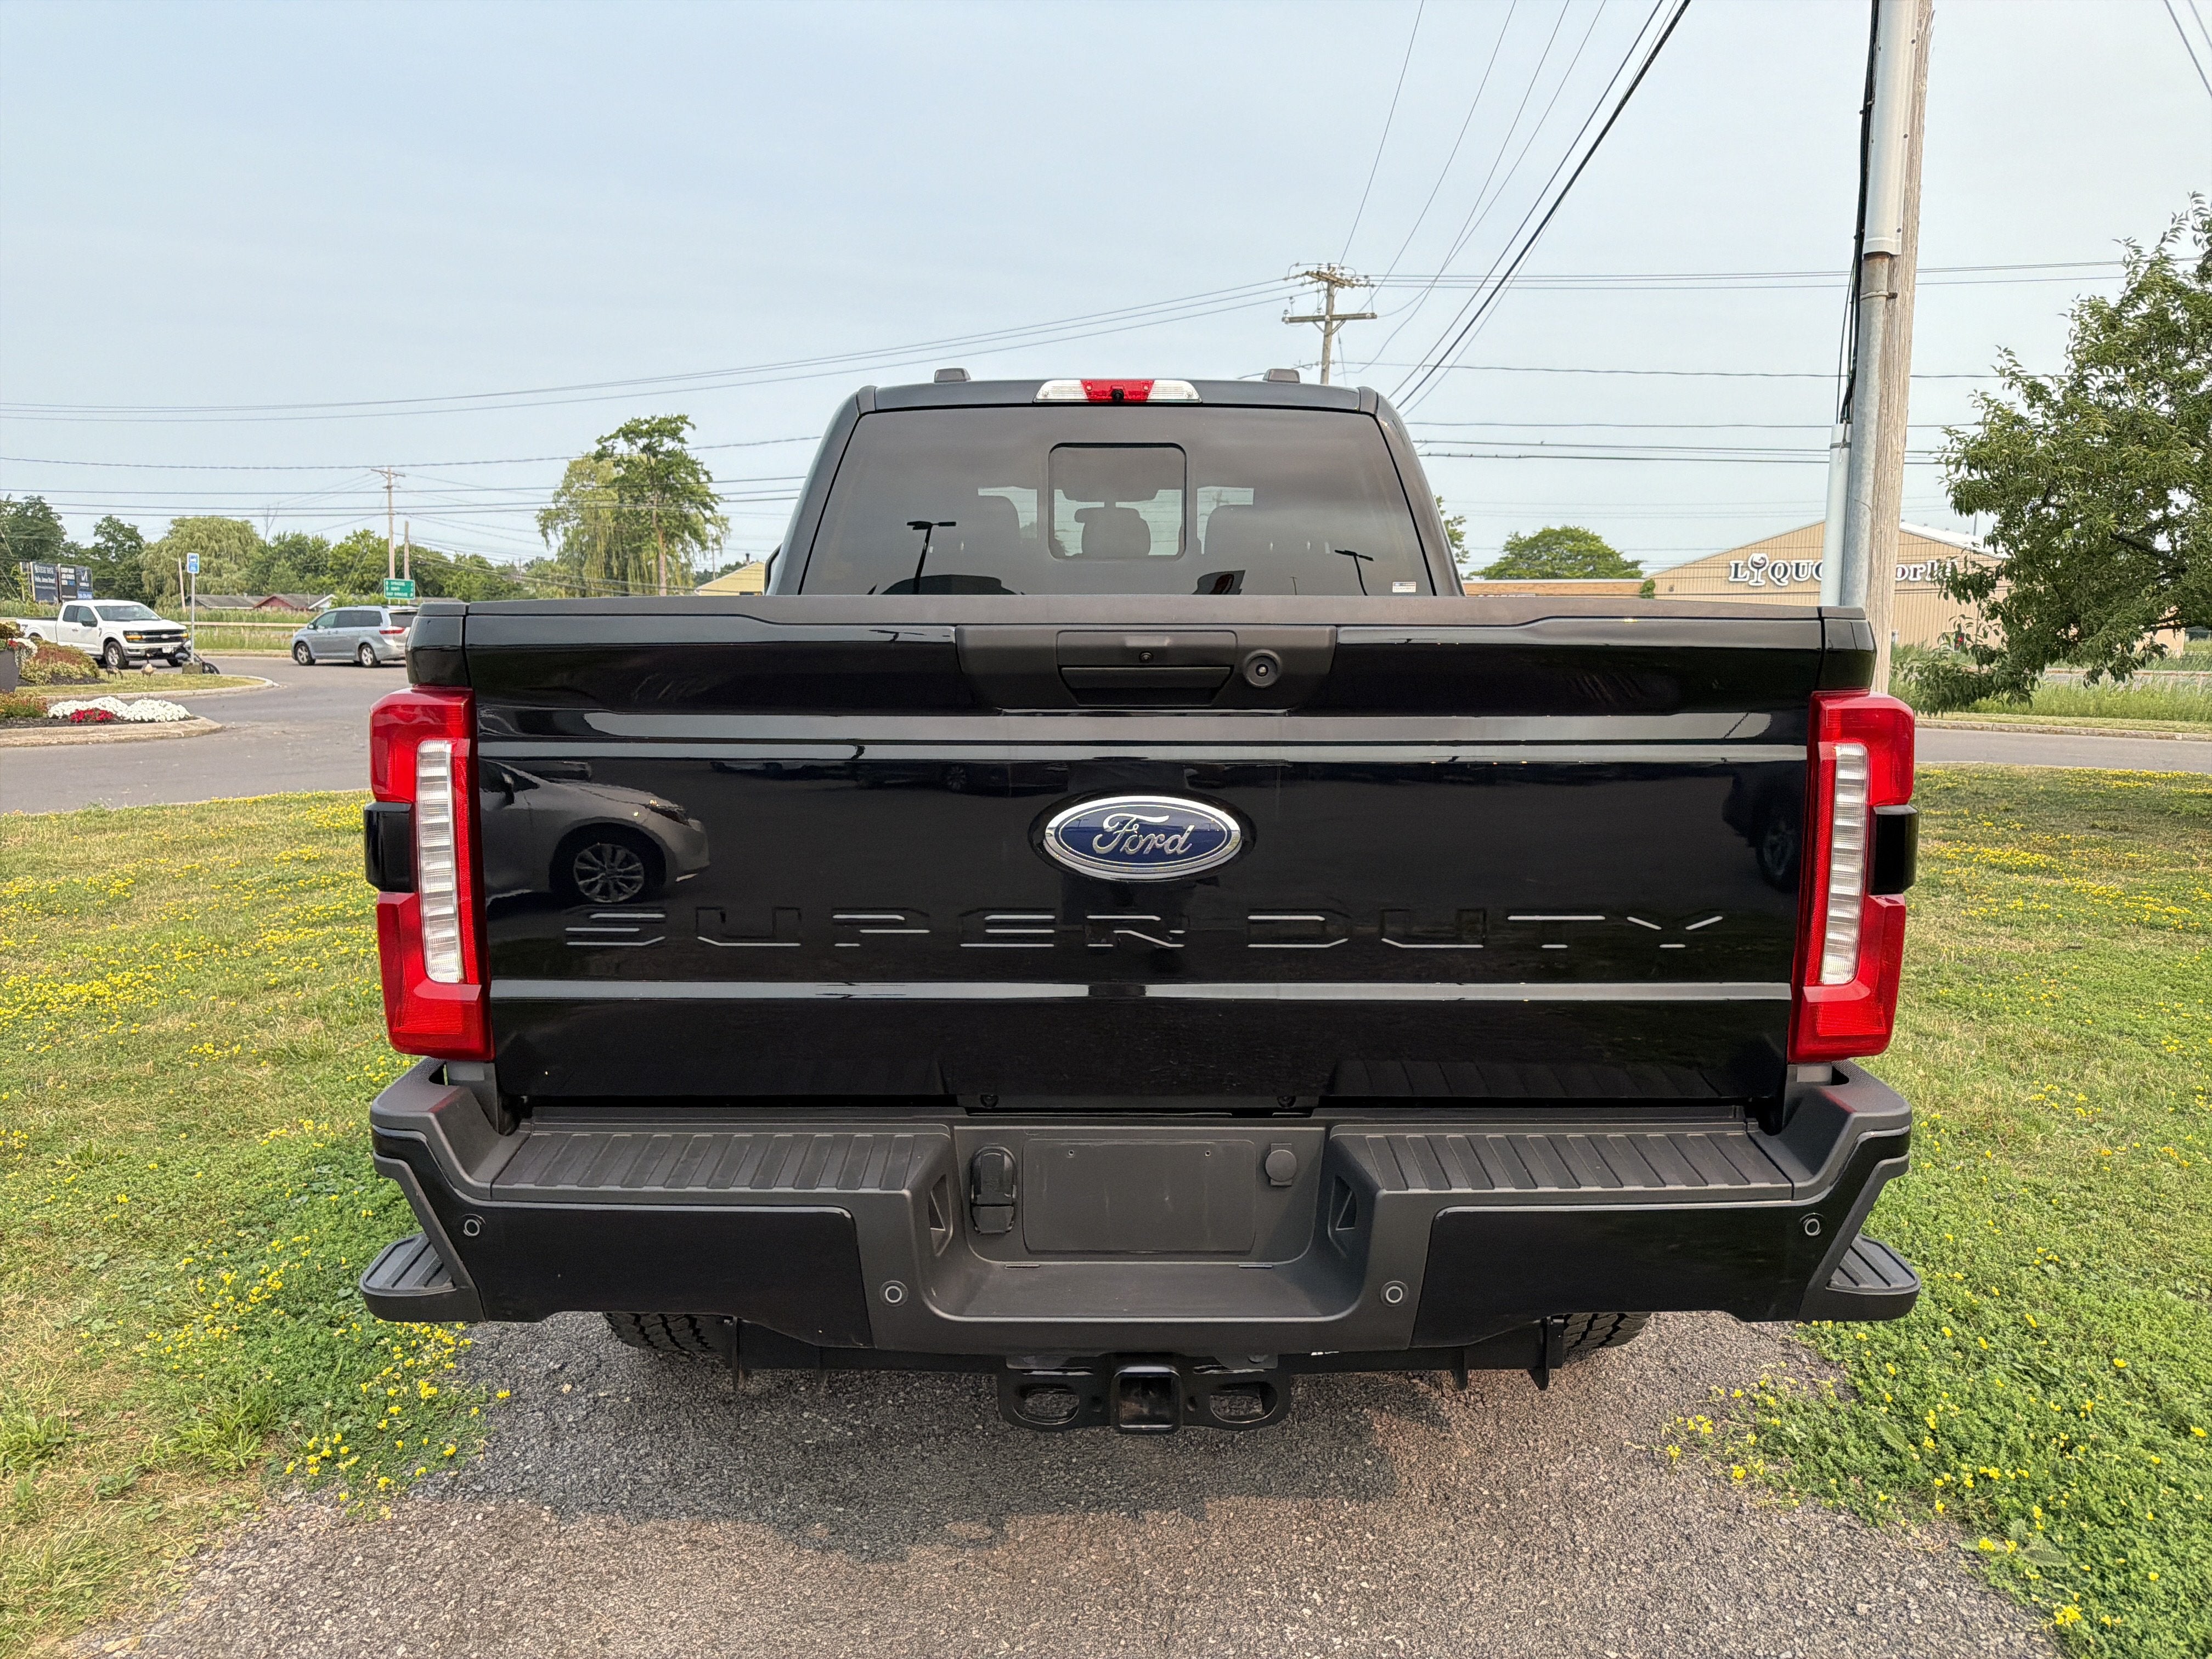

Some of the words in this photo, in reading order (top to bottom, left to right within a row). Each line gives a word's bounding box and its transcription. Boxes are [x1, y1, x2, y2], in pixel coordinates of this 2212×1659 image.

[1729, 553, 1822, 586] LIQU
[1896, 560, 1957, 582] orl
[1092, 813, 1195, 855] Ford
[564, 906, 1190, 948] SUPER
[1248, 907, 1724, 949] DUTY
